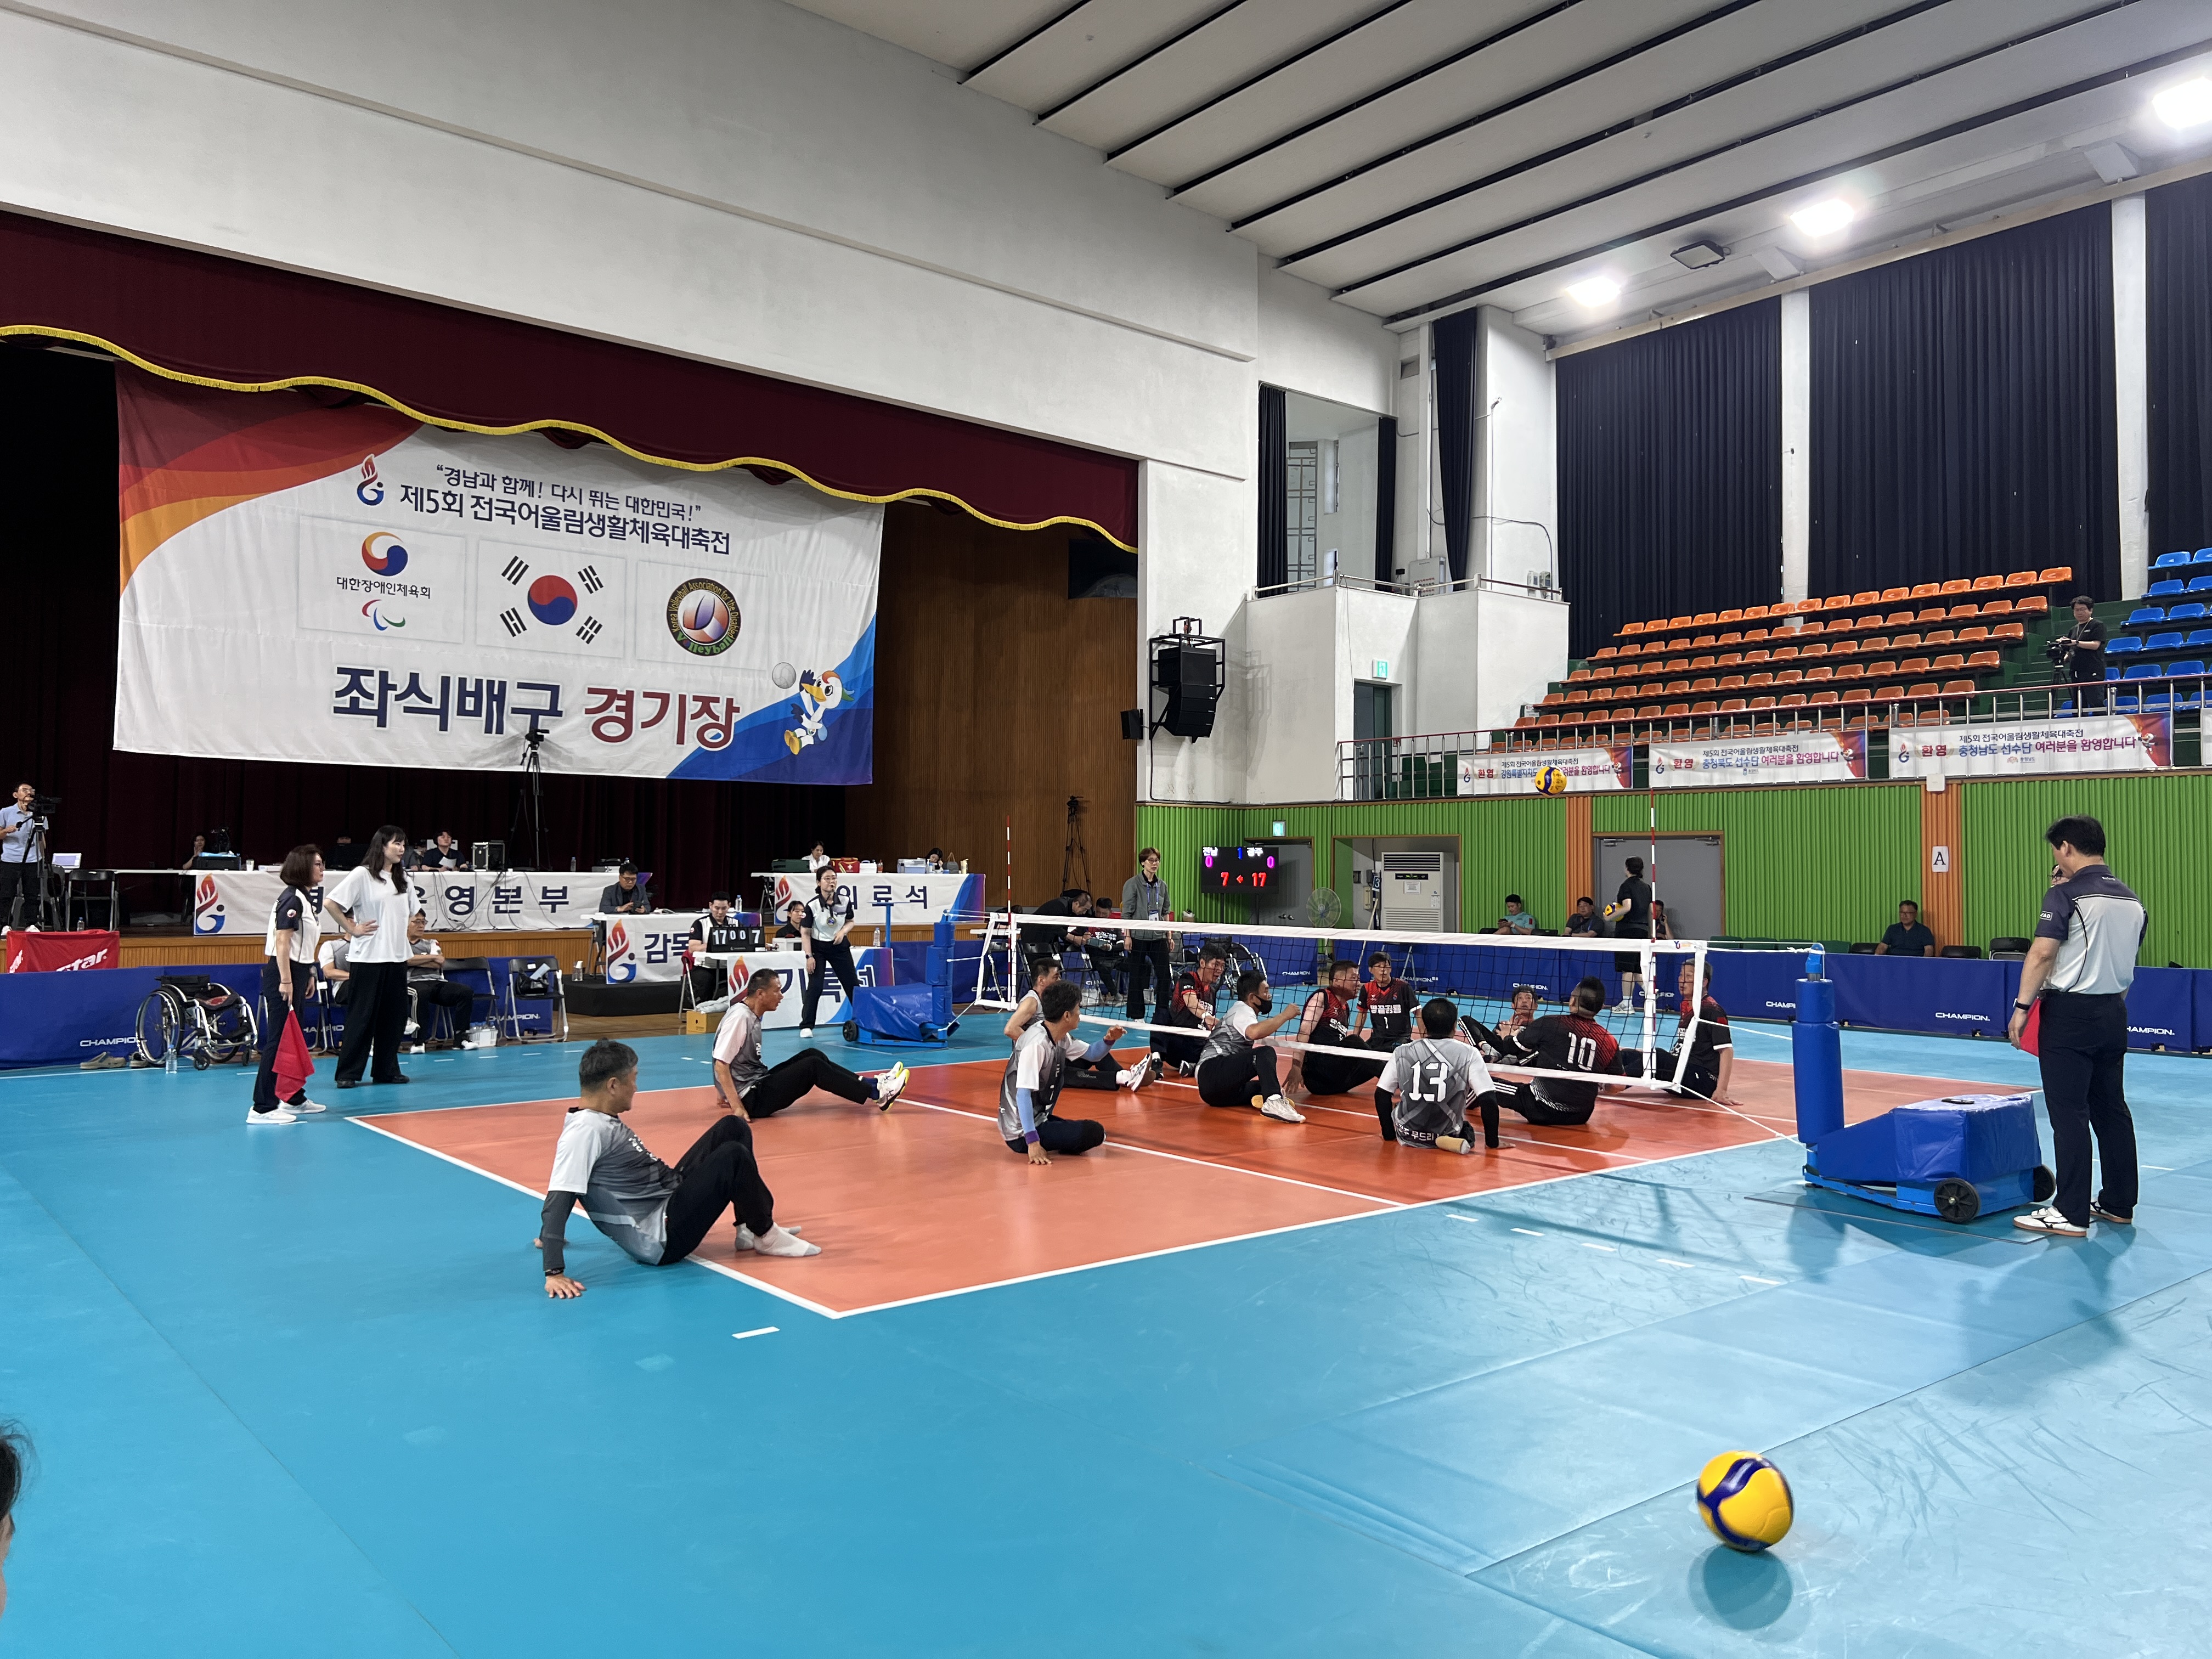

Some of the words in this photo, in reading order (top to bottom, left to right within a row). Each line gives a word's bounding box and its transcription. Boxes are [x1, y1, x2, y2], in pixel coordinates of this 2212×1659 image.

[502, 475, 542, 499] 함께!
[551, 484, 582, 505] 다시
[589, 490, 619, 511] 뛰는
[400, 484, 464, 518] 제5회
[470, 495, 730, 555] 전국어울림생활체육대축전
[337, 577, 431, 599] 대한장애인체육회
[688, 582, 721, 595] Association
[721, 589, 731, 601] for
[668, 584, 690, 612] Volleyball
[727, 599, 736, 611] the
[670, 613, 681, 633] Korea
[727, 612, 740, 640] Disabled
[333, 666, 563, 735] 좌식배구
[584, 687, 740, 749] 경기장
[1960, 735, 1980, 743] 제5회
[1982, 729, 2084, 742] 전국어울림생활체육대축전
[1721, 744, 1799, 756] 전국어울림생활체육대축전
[1921, 744, 1947, 757] 환영
[1959, 744, 1998, 757] 충청남도
[2001, 743, 2032, 755] 선수단
[2035, 740, 2077, 753] 여러분을
[2080, 736, 2136, 751] 환영합니다
[1673, 758, 1694, 769] 환영
[1703, 757, 1733, 769] 충청북도
[1735, 756, 1759, 768] 선수단
[1762, 753, 1793, 766] 여러분을
[1796, 751, 1839, 764] 환영합니다
[1478, 769, 1494, 778] 환영
[1581, 764, 1610, 776] 환영합니다
[1237, 847, 1243, 860] 1
[1933, 851, 1946, 865] A
[1205, 855, 1214, 868] 0
[1266, 856, 1275, 868] 0
[1221, 872, 1229, 887] 7
[1252, 872, 1267, 887] 17
[713, 929, 727, 945] 17
[730, 929, 736, 940] 0
[740, 929, 746, 940] 0
[752, 929, 760, 944] 7
[1383, 1017, 1389, 1029] 1
[1936, 1012, 1990, 1022] CHAMPION
[80, 1036, 137, 1047] CHAMPIO
[1567, 1032, 1596, 1071] 10
[1409, 1060, 1449, 1102] 13
